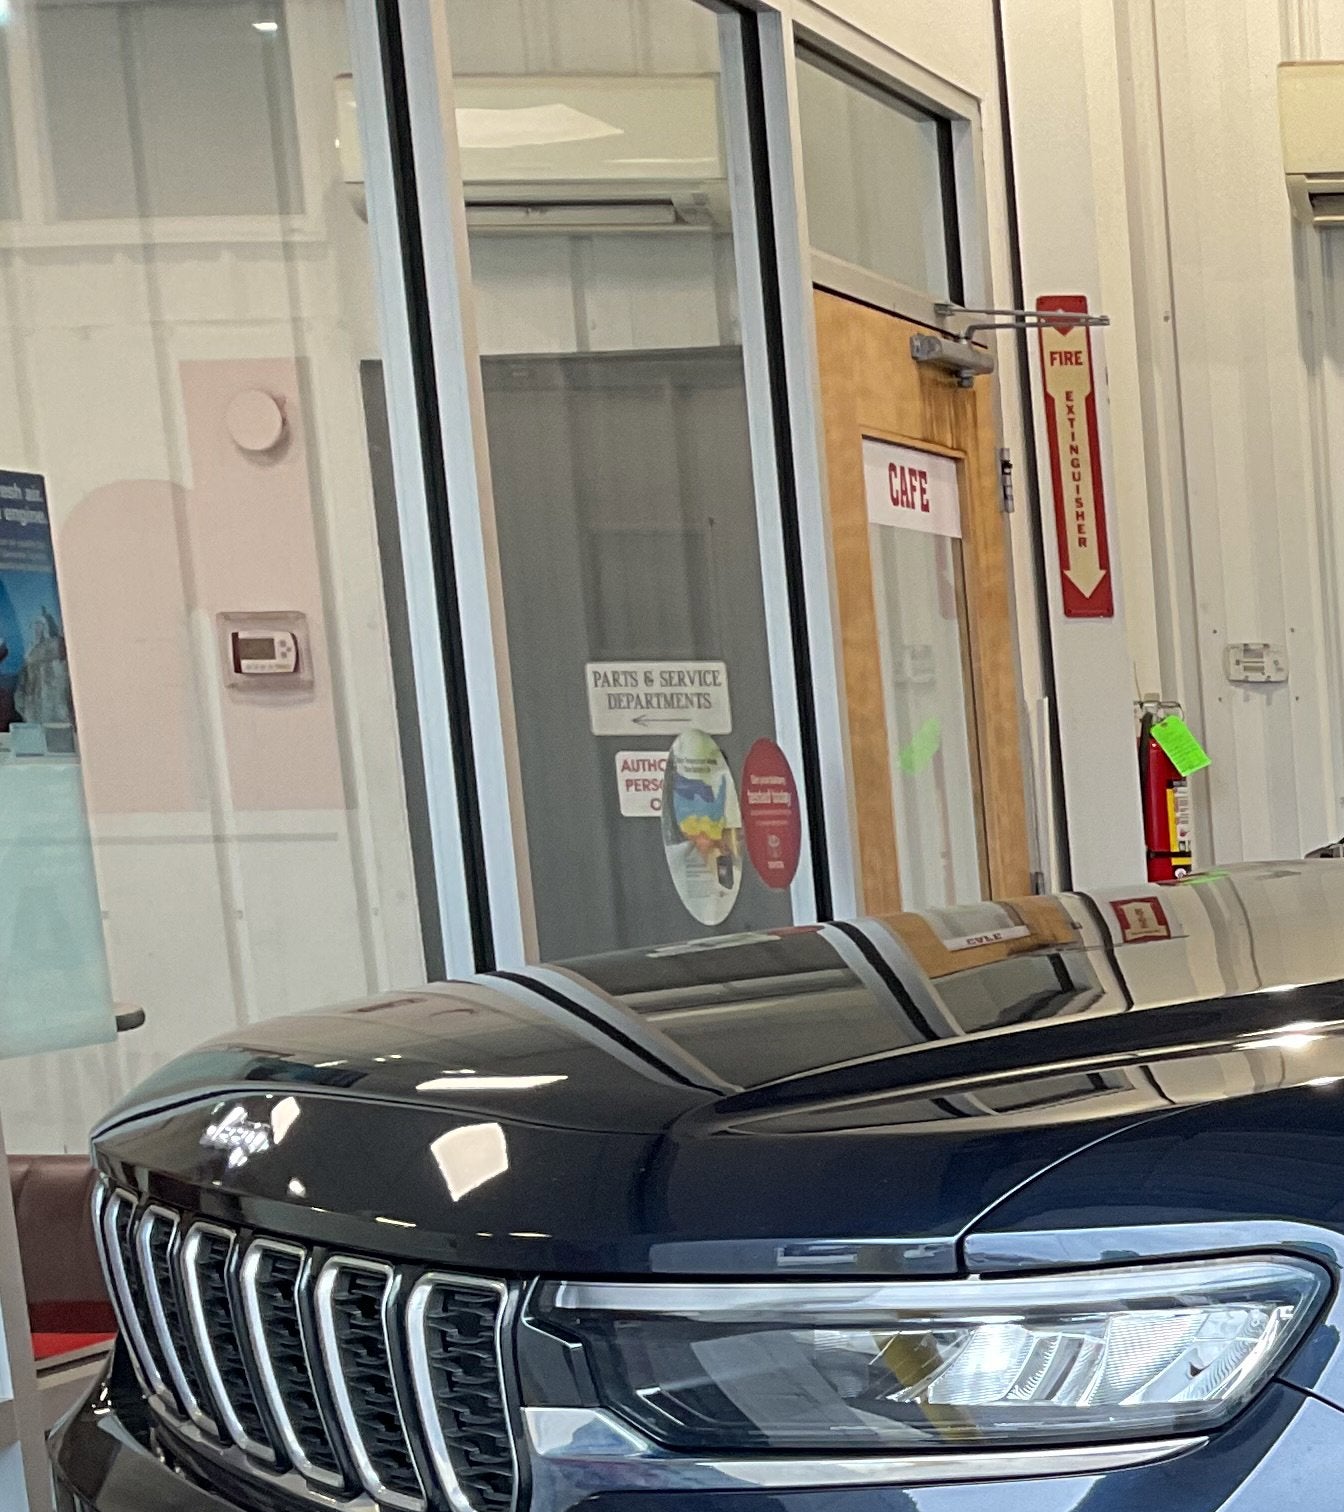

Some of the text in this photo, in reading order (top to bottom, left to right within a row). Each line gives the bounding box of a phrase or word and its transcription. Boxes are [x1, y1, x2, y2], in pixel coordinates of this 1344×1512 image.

[1049, 350, 1084, 367] FIRE
[1064, 390, 1088, 548] EXTINGUISHER
[888, 462, 930, 513] CAFE
[592, 669, 722, 688] PARTS & SERVICE
[607, 692, 713, 710] DEPARTMENTS
